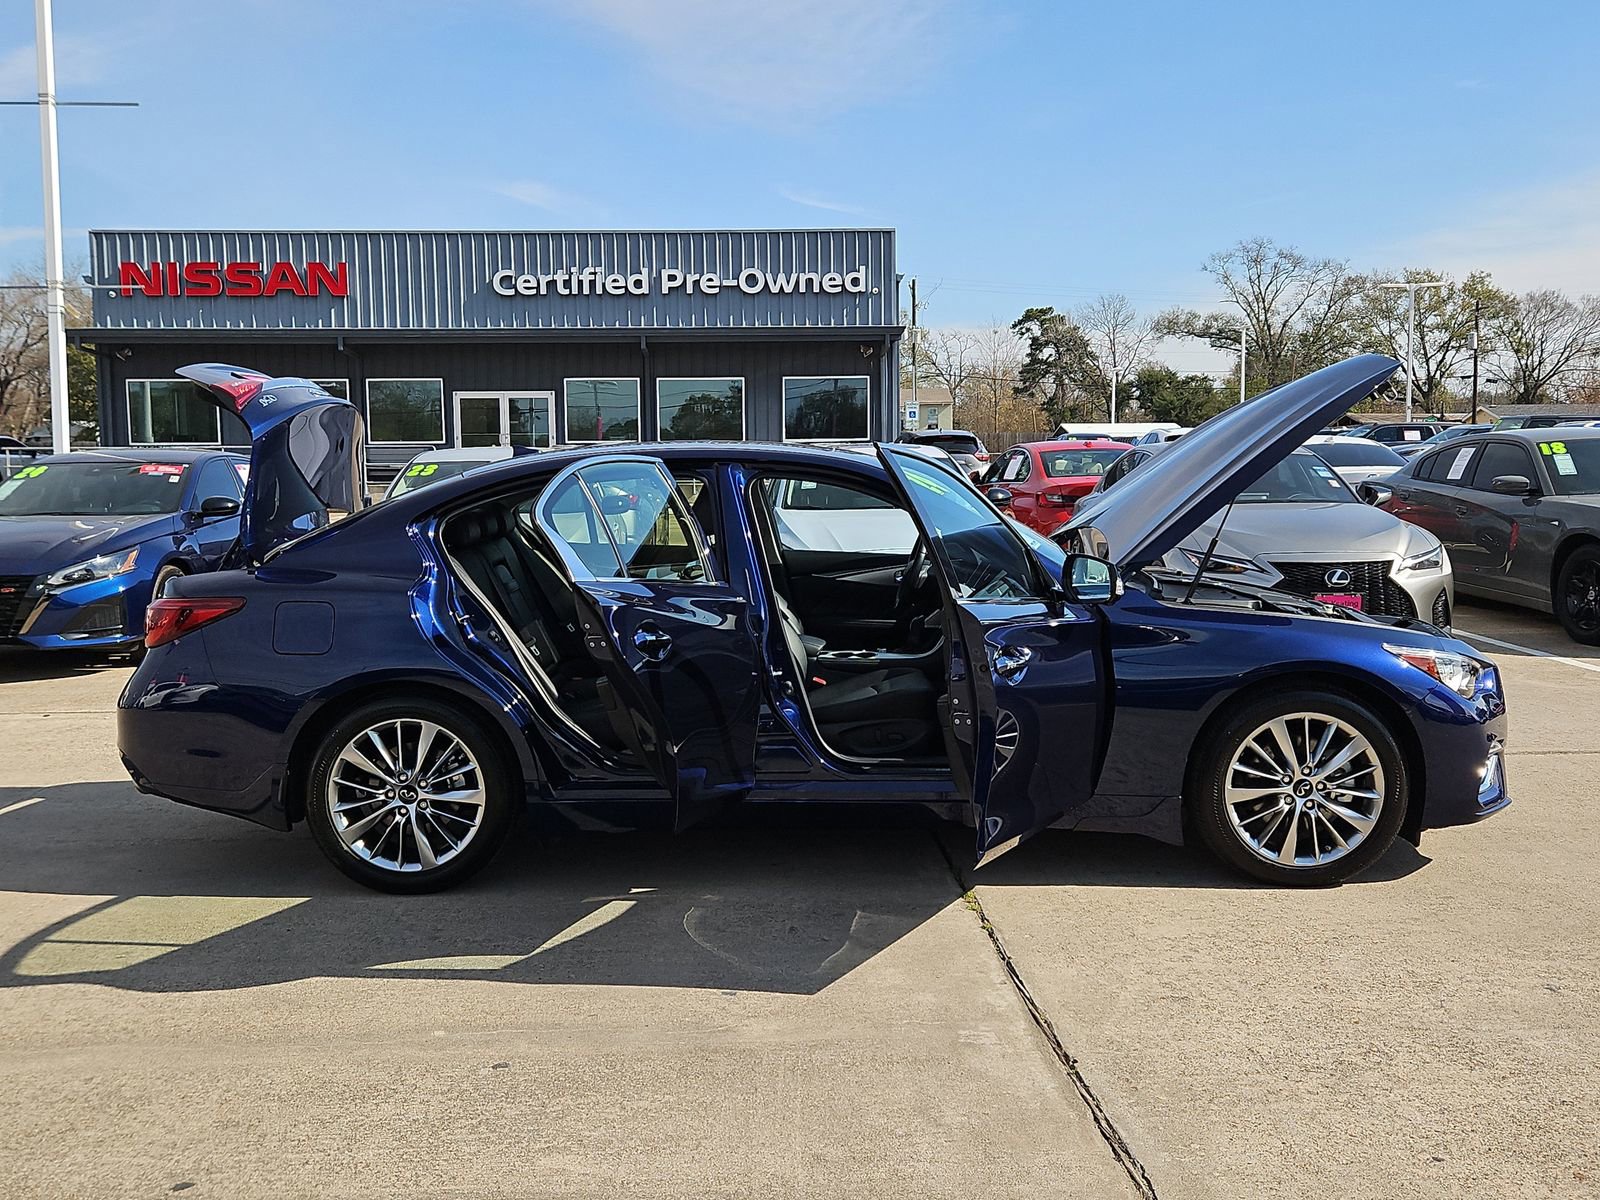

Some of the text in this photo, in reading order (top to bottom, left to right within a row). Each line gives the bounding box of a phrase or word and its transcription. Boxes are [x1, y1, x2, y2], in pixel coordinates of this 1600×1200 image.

[119, 262, 349, 297] NISSAN
[492, 265, 867, 296] Certified Pre-Owned
[1539, 441, 1567, 455] 18
[406, 464, 439, 477] 23
